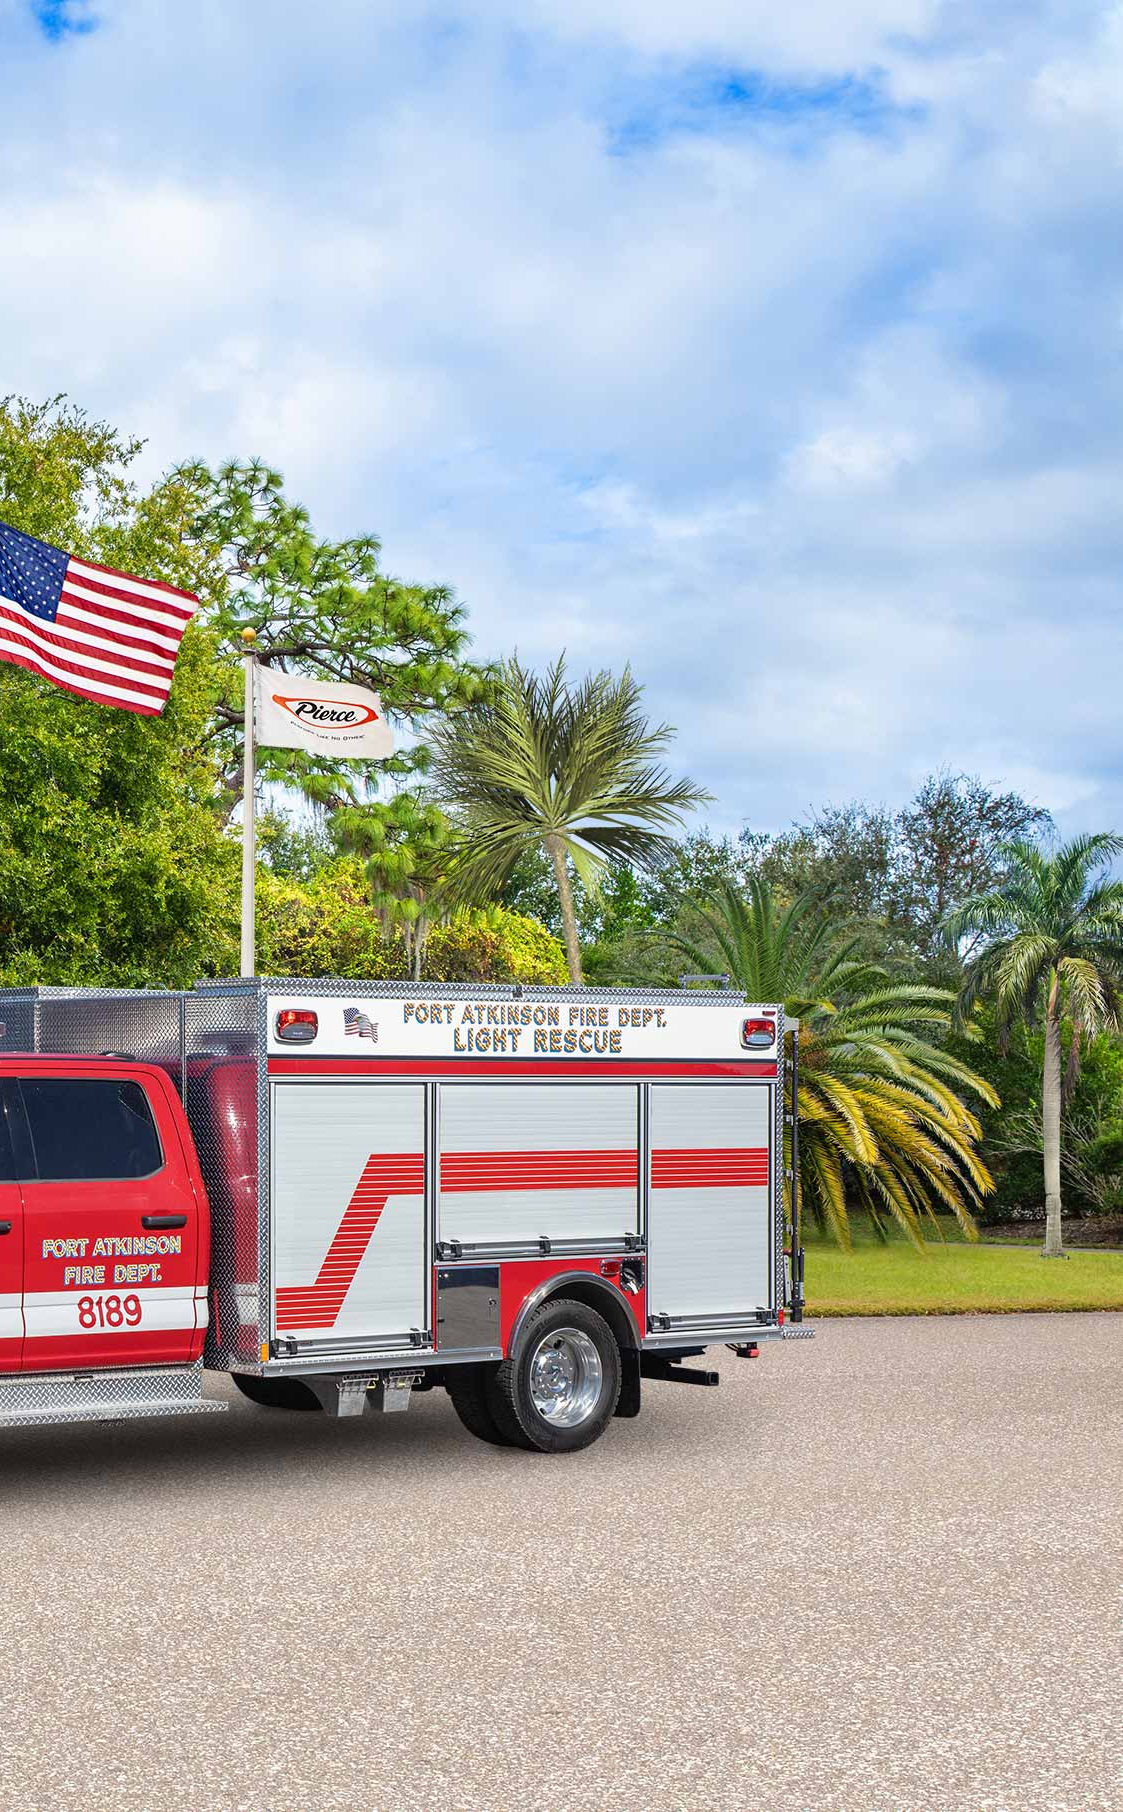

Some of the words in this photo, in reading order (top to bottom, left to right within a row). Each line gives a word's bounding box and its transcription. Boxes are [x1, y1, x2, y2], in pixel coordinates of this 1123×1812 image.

[295, 701, 356, 722] Pierce
[403, 1002, 456, 1024] FORT
[461, 1004, 560, 1026] ATKINSON
[569, 1006, 609, 1027] FIRE
[618, 1007, 668, 1028] DEPT.
[454, 1027, 522, 1052] LIGHT
[533, 1028, 623, 1053] RESCUE
[42, 1239, 89, 1258] FORT
[92, 1235, 181, 1257] ATKINSON
[63, 1265, 105, 1286] FIRE
[113, 1263, 163, 1284] DEPT.
[78, 1294, 142, 1328] 8189
